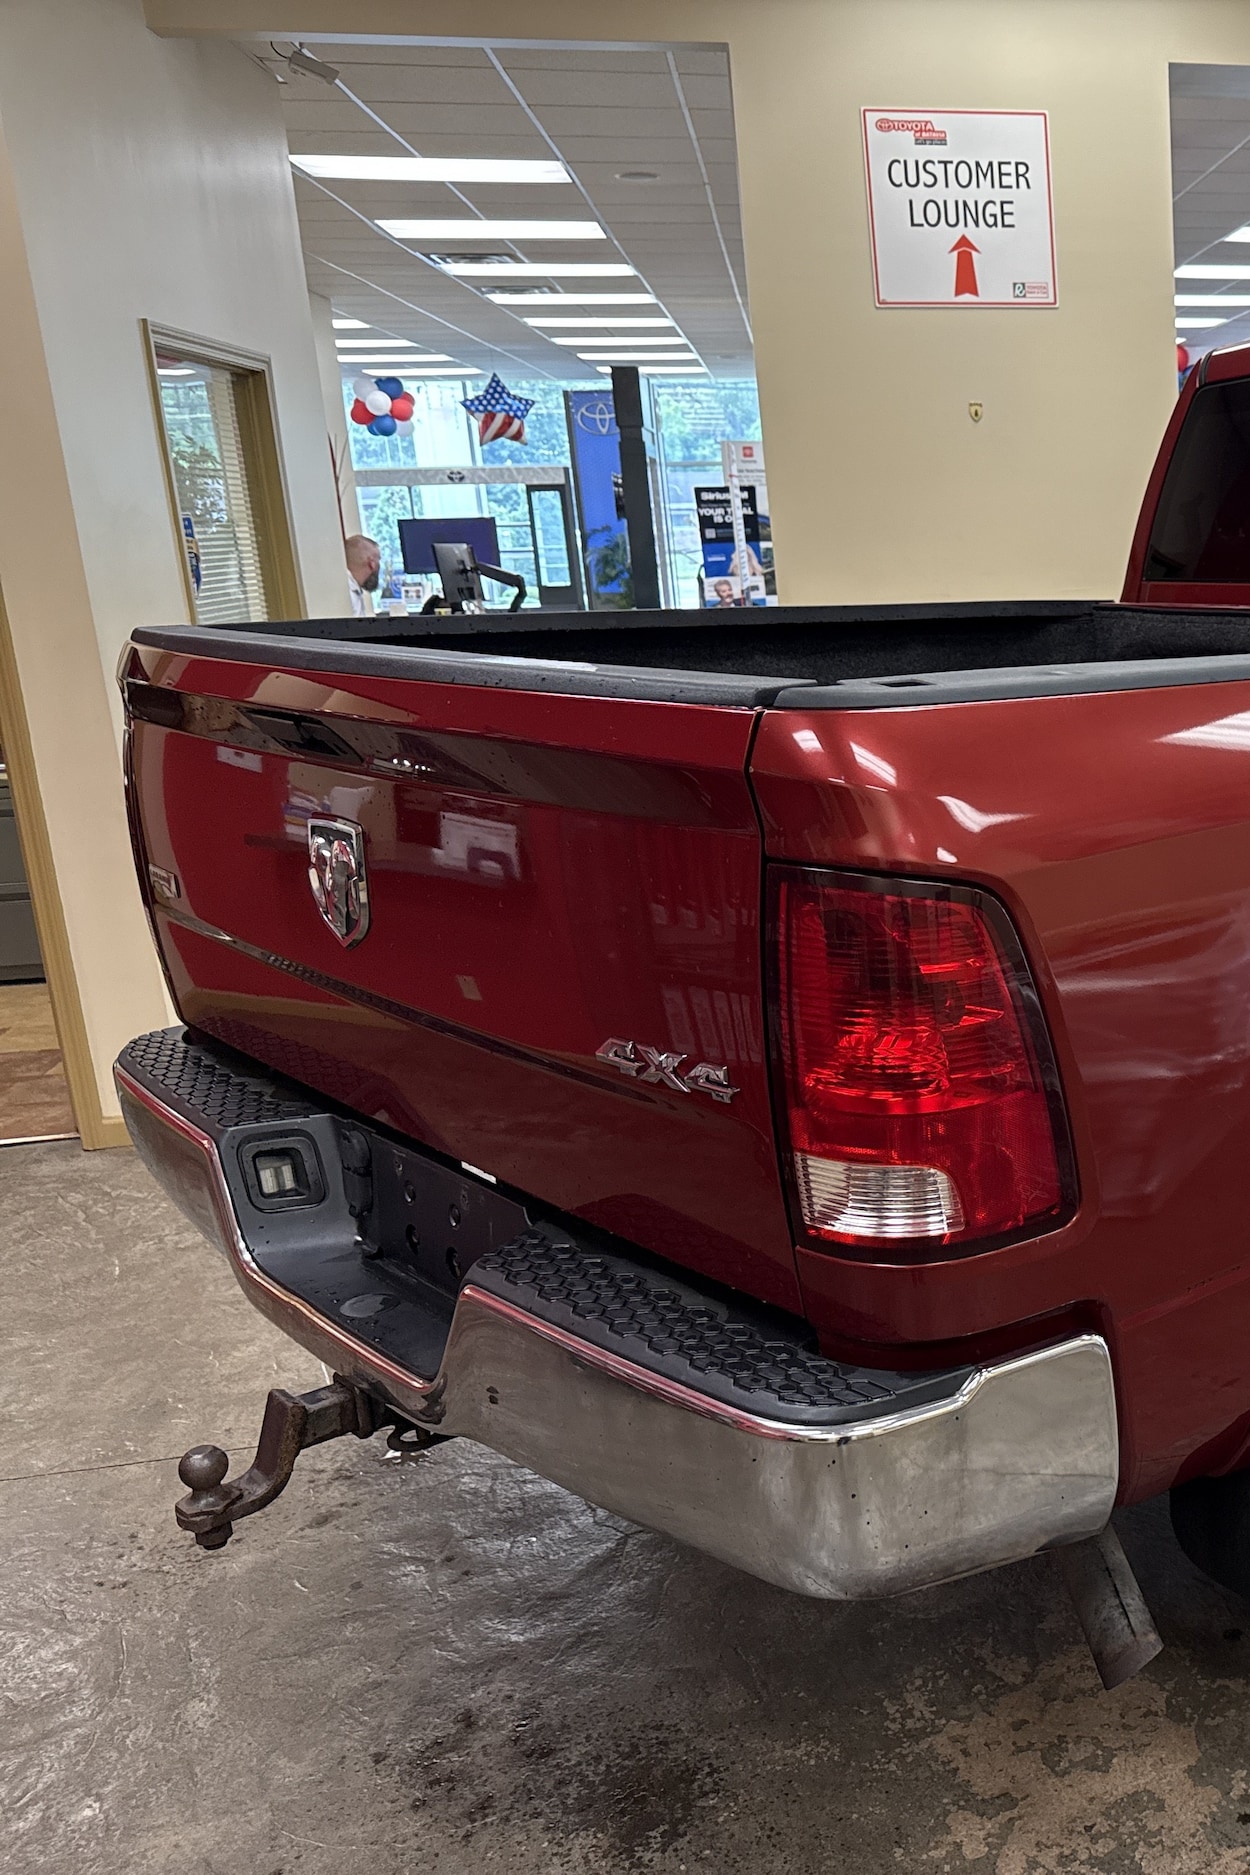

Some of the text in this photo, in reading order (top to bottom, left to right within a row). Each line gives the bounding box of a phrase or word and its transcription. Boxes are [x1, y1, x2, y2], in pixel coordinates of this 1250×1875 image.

[893, 121, 934, 131] TOYOTA
[888, 159, 1031, 189] CUSTOMER
[909, 199, 1016, 228] LOUNGE
[698, 507, 725, 517] YOUR
